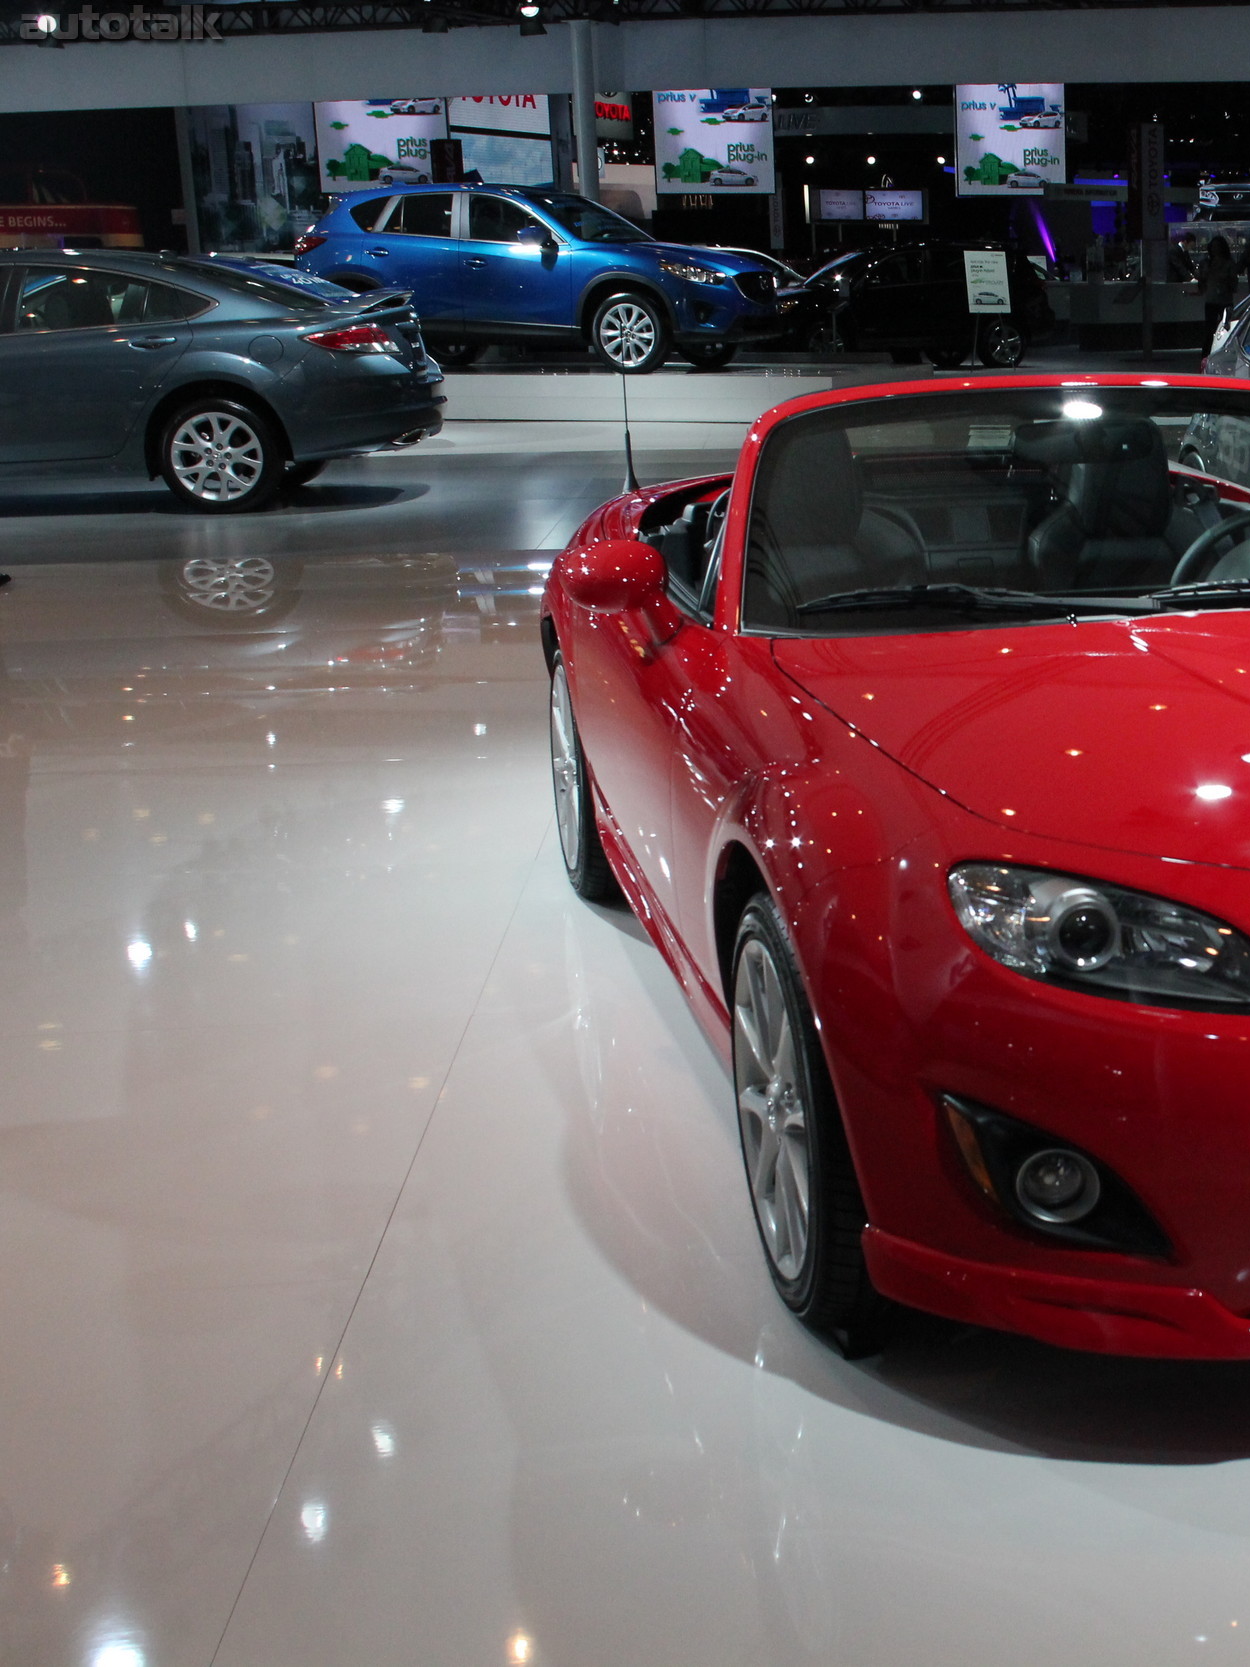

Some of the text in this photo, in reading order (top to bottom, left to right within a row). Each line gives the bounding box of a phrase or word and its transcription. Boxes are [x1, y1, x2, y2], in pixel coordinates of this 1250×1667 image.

[594, 101, 632, 121] OYOTA
[961, 100, 996, 112] prius v
[397, 137, 427, 149] prius
[727, 142, 755, 155] prius
[727, 151, 768, 164] plug-in
[1023, 147, 1049, 159] prius
[1147, 127, 1159, 190] TOYOTA
[1023, 155, 1060, 167] plug-in
